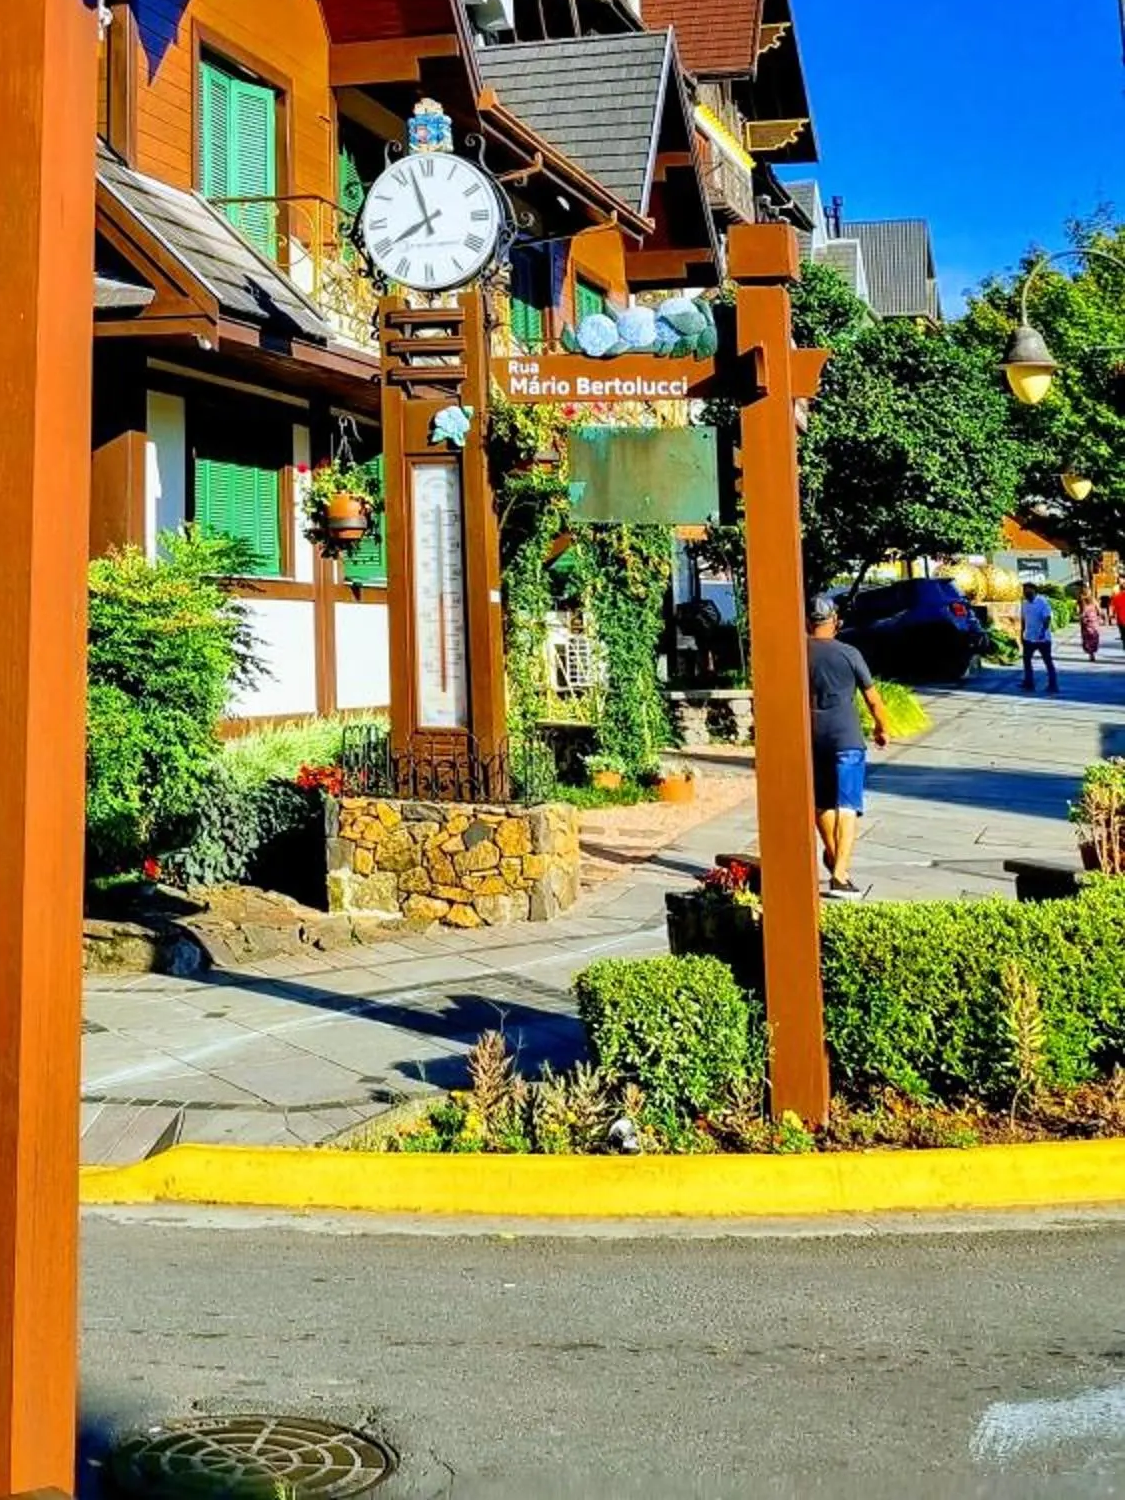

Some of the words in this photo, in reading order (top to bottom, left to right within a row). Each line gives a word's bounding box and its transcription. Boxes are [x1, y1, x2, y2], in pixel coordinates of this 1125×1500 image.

[508, 360, 539, 374] Rua
[509, 375, 570, 395] Mário
[576, 376, 688, 395] Bertolucci
